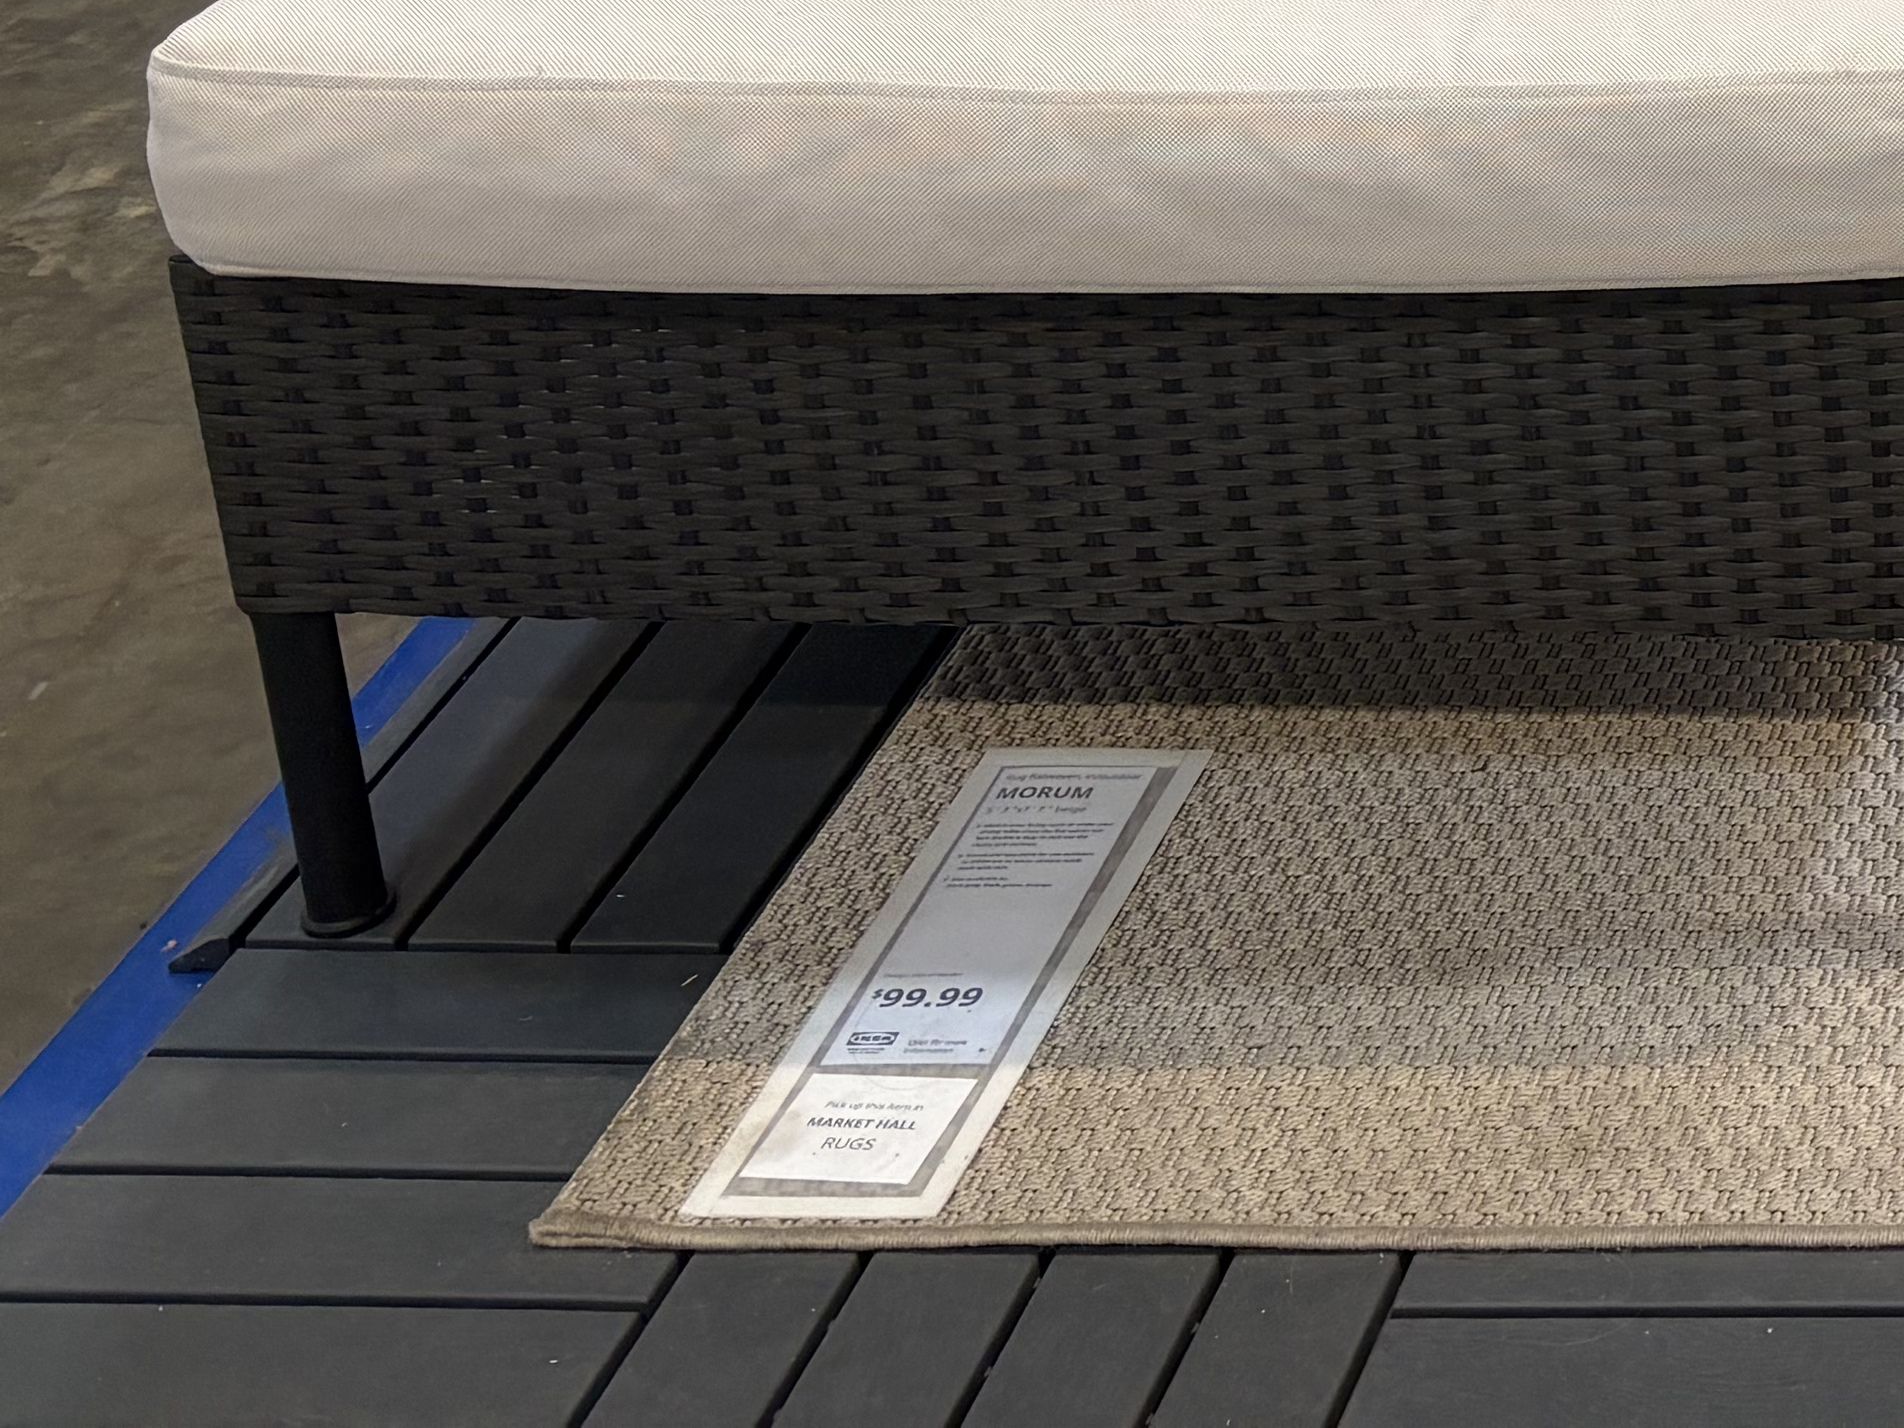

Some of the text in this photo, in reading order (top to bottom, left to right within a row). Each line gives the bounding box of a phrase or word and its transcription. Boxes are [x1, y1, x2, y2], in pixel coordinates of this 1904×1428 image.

[995, 786, 1095, 800] MORUM
[871, 987, 984, 1008] $99.99
[824, 1100, 925, 1112] Pick up this item in
[806, 1116, 917, 1131] MARKET HALL
[820, 1136, 877, 1151] RUGS
